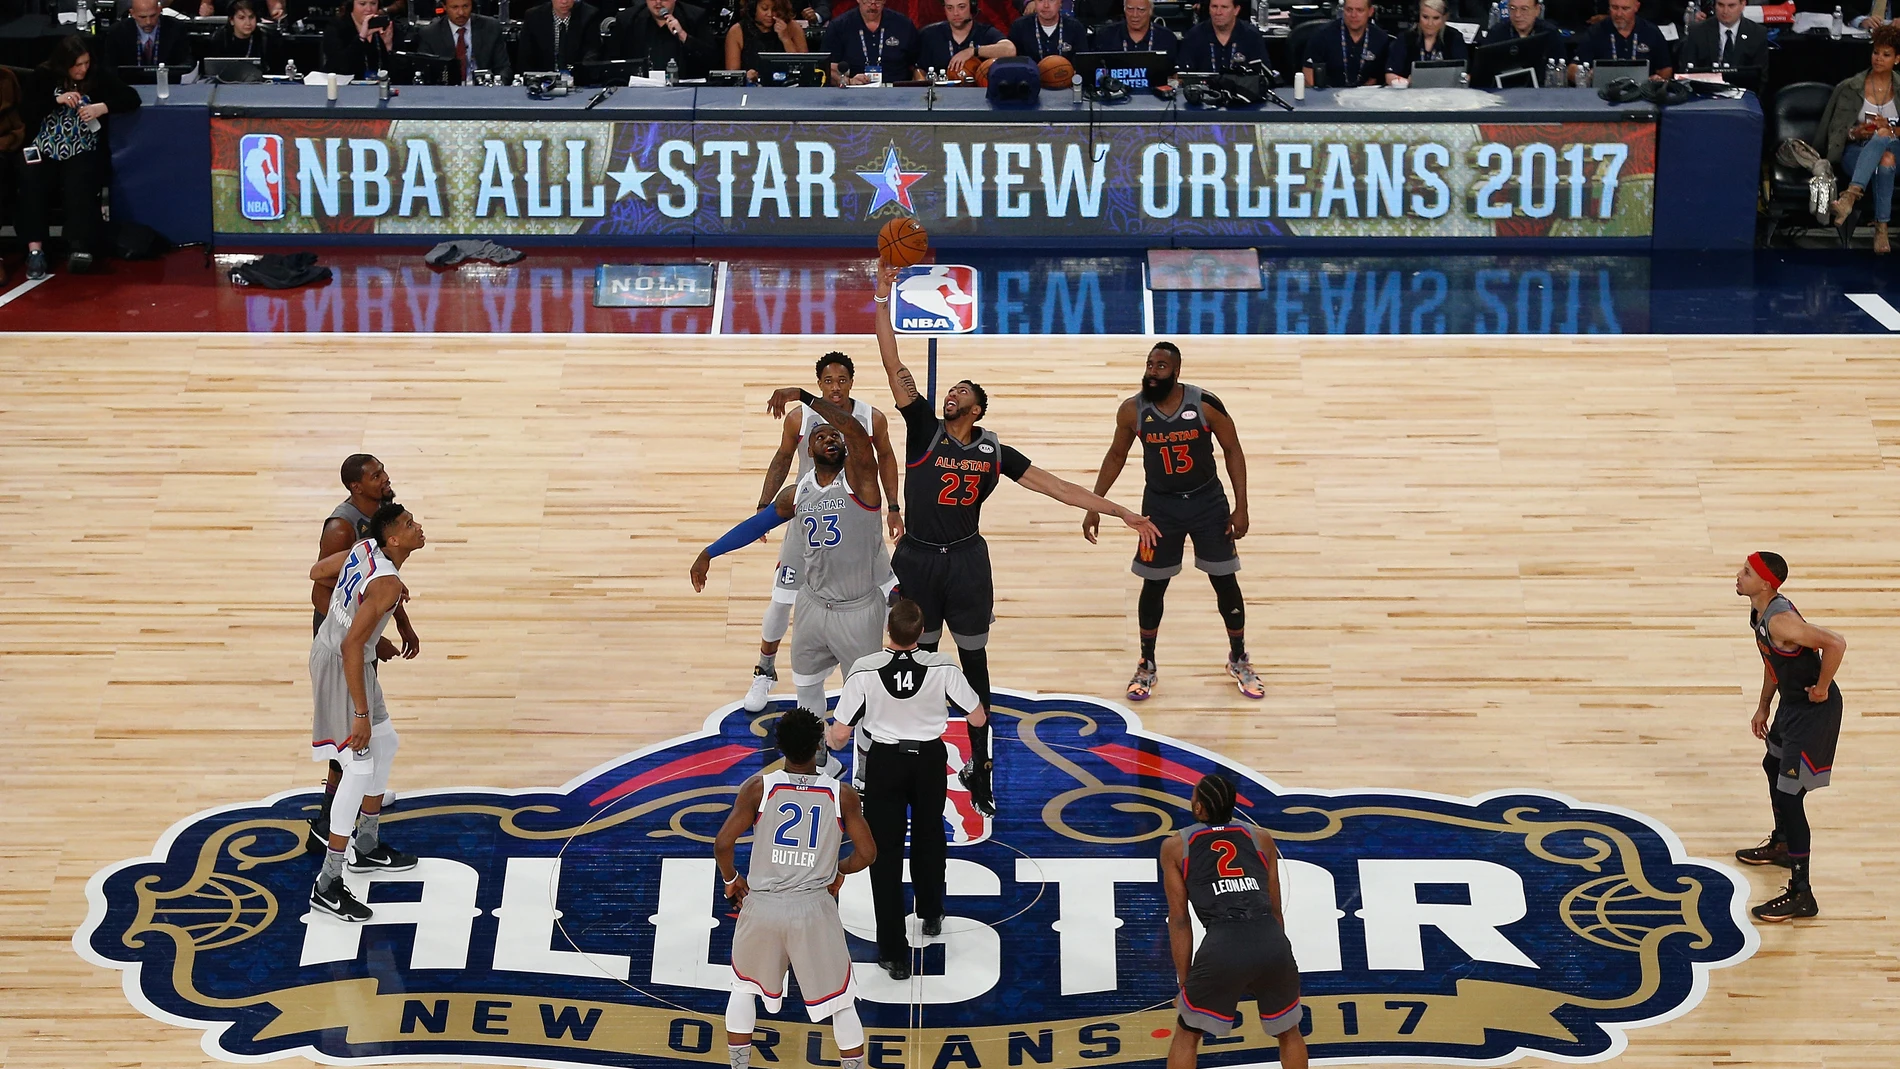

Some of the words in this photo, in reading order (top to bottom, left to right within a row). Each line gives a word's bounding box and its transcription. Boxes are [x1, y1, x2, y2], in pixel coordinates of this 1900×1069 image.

[1110, 68, 1147, 78] REPLAY
[295, 138, 442, 217] NBA
[942, 142, 1110, 218] NEW
[1140, 143, 1451, 219] ORLEANS
[1475, 143, 1629, 219] 2017
[247, 201, 269, 213] NBA
[611, 277, 697, 294] NOLA
[902, 318, 949, 329] NBA
[1160, 444, 1193, 475] 13
[938, 472, 980, 506] 23
[803, 514, 842, 548] 23
[893, 671, 914, 692] 14
[773, 801, 822, 849] 21
[771, 849, 815, 868] BUTLER
[1211, 840, 1245, 877] 2
[1212, 877, 1260, 896] LEONARD
[400, 999, 603, 1042] NEW
